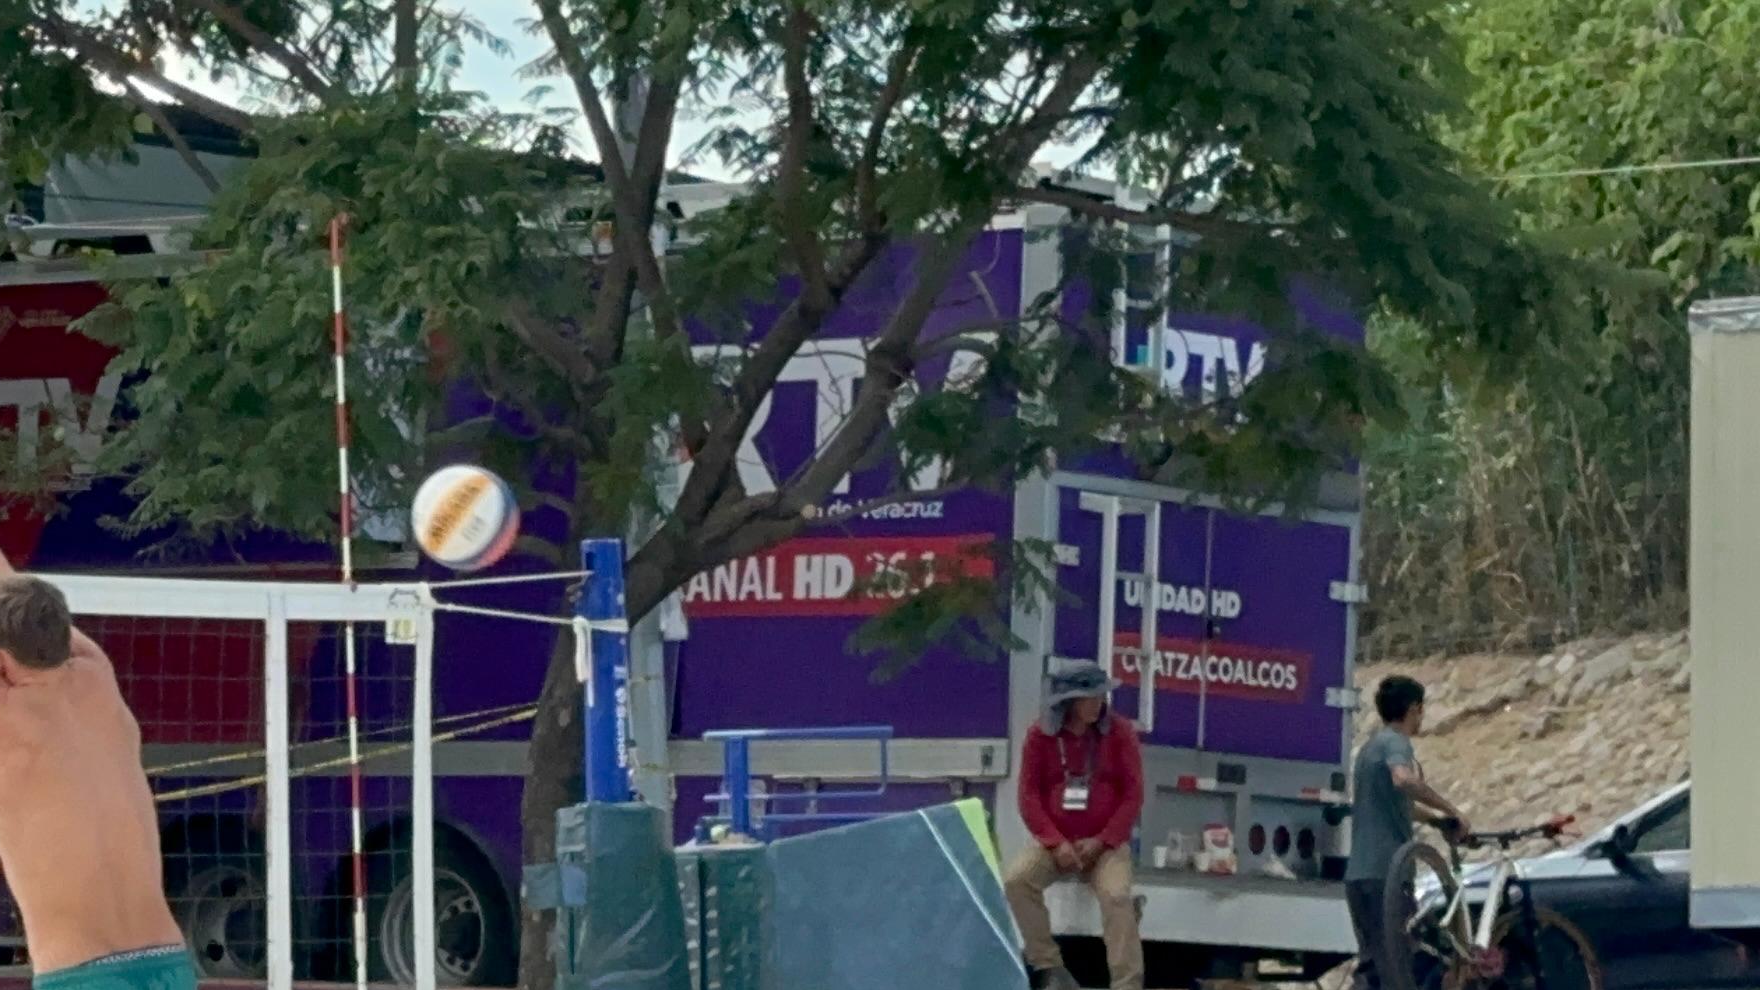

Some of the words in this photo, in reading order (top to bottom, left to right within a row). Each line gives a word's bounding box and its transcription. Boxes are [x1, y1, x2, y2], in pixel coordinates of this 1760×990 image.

[678, 555, 783, 602] ANAL
[793, 554, 855, 600] HD
[1124, 578, 1206, 615] UIDAD
[1211, 589, 1241, 618] HD
